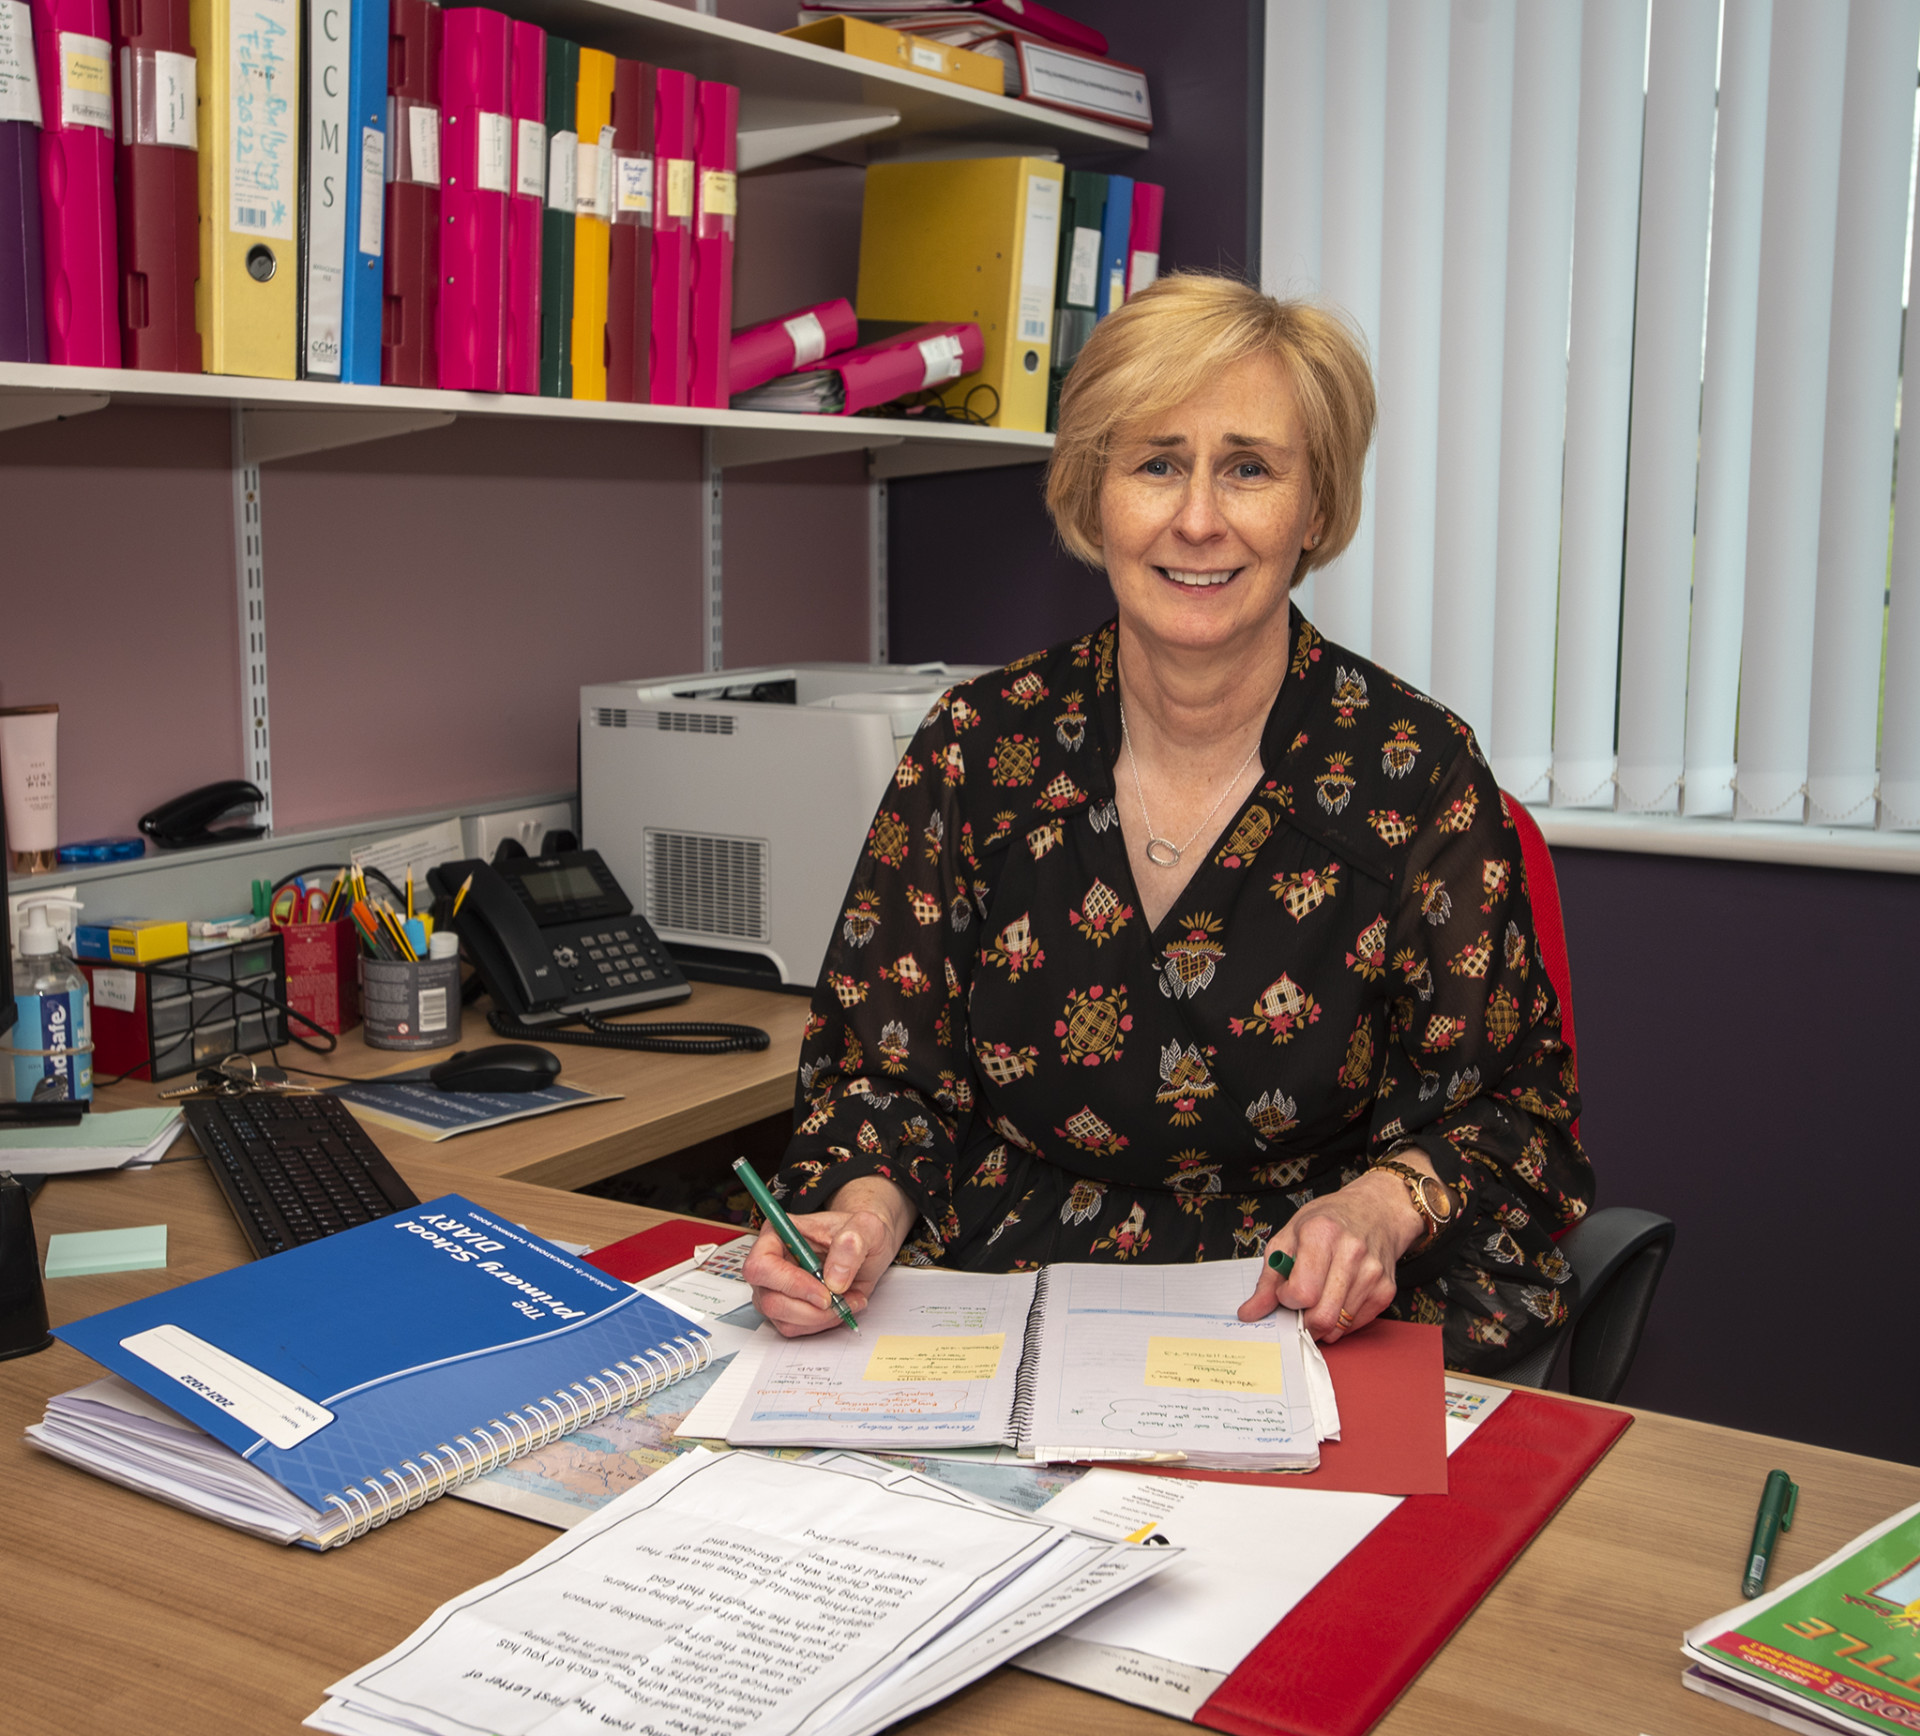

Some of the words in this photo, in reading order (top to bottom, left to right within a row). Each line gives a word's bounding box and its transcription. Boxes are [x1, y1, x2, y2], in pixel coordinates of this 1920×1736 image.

[236, 29, 259, 76] Feb
[236, 93, 254, 162] 2022
[311, 341, 338, 354] CCMS
[467, 1210, 492, 1227] BOOKS
[419, 1213, 505, 1253] DIARY
[490, 1223, 527, 1244] PLANNING
[394, 1220, 479, 1262] School
[526, 1241, 573, 1269] EDUCATIONAL
[510, 1300, 545, 1320] The
[180, 1374, 234, 1407] 2021-2022
[857, 1422, 892, 1430] today
[933, 1423, 974, 1432] Things
[702, 1536, 728, 1547] and
[802, 1528, 835, 1542] Lord
[838, 1538, 859, 1547] the
[635, 1545, 662, 1557] that
[664, 1553, 689, 1562] way
[693, 1546, 743, 1564] because
[729, 1542, 782, 1564] glorious
[880, 1548, 917, 1561] Word
[742, 1561, 771, 1575] God
[795, 1562, 821, 1576] who
[839, 1562, 862, 1574] for
[921, 1558, 945, 1568] The
[716, 1565, 747, 1580] done
[772, 1568, 787, 1578] to
[863, 1567, 926, 1586] powerful
[646, 1573, 675, 1587] God
[789, 1576, 835, 1594] honour
[676, 1582, 705, 1596] that
[765, 1581, 811, 1600] should
[871, 1583, 912, 1599] Jesus
[562, 1591, 607, 1609] preach
[648, 1589, 694, 1609] helping
[837, 1588, 873, 1605] bring
[873, 1599, 899, 1608] will
[712, 1606, 742, 1622] gift
[813, 1595, 887, 1619] Everything
[767, 1613, 790, 1622] the
[741, 1620, 764, 1630] the
[794, 1620, 825, 1632] with
[556, 1631, 579, 1643] the
[684, 1626, 714, 1642] gift
[768, 1628, 800, 1641] have
[802, 1636, 827, 1646] you
[843, 1631, 860, 1639] do
[496, 1638, 520, 1654] has
[582, 1640, 595, 1648] in
[714, 1640, 736, 1652] the
[829, 1643, 847, 1651] If
[522, 1647, 549, 1661] you
[594, 1646, 629, 1658] used
[694, 1650, 724, 1660] gift
[740, 1647, 773, 1663] have
[795, 1648, 834, 1660] God's
[544, 1656, 564, 1667] of
[631, 1654, 648, 1666] be
[724, 1659, 758, 1671] your
[775, 1658, 802, 1668] you
[1742, 1653, 1776, 1672] CLASS
[461, 1668, 482, 1678] of
[566, 1661, 598, 1678] each
[611, 1663, 635, 1676] one
[650, 1665, 665, 1675] to
[718, 1671, 737, 1679] of
[759, 1668, 783, 1678] use
[800, 1665, 820, 1674] If
[1115, 1665, 1159, 1683] World
[668, 1670, 704, 1684] gifts
[787, 1675, 806, 1684] So
[1776, 1668, 1810, 1686] FIRST
[484, 1675, 531, 1696] Letter
[637, 1677, 667, 1692] with
[739, 1678, 792, 1695] service
[1164, 1680, 1190, 1694] The
[532, 1691, 569, 1707] First
[667, 1687, 724, 1710] blessed
[703, 1681, 776, 1707] wonderful
[572, 1698, 595, 1714] the
[649, 1700, 679, 1710] and
[681, 1707, 746, 1729] Brothers
[726, 1704, 762, 1721] been
[600, 1713, 635, 1731] from
